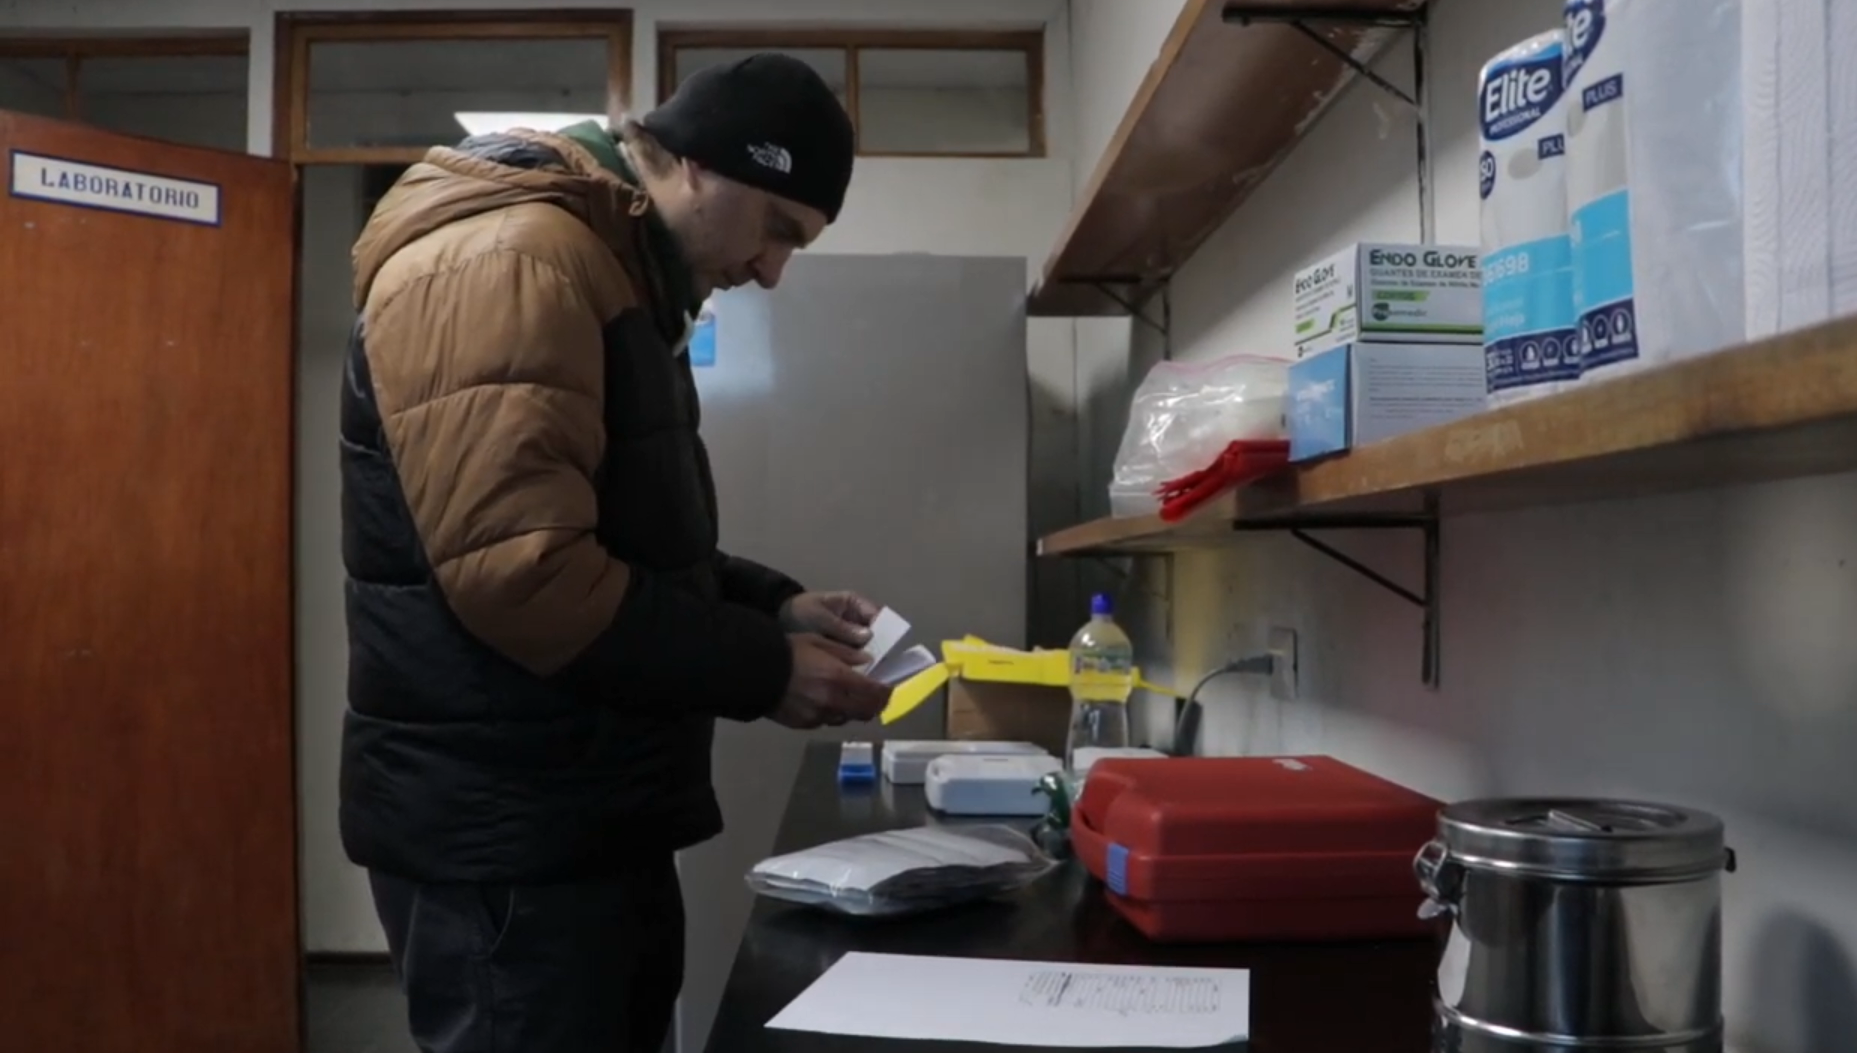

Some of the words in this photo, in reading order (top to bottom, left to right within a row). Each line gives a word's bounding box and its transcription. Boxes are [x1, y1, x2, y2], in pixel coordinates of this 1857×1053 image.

[1486, 68, 1551, 122] Elite
[1585, 79, 1618, 106] PLUS
[1543, 137, 1564, 157] PLU
[40, 167, 199, 209] LABORATORIO
[1370, 249, 1417, 267] ENDO
[1423, 250, 1477, 269] GLOVE
